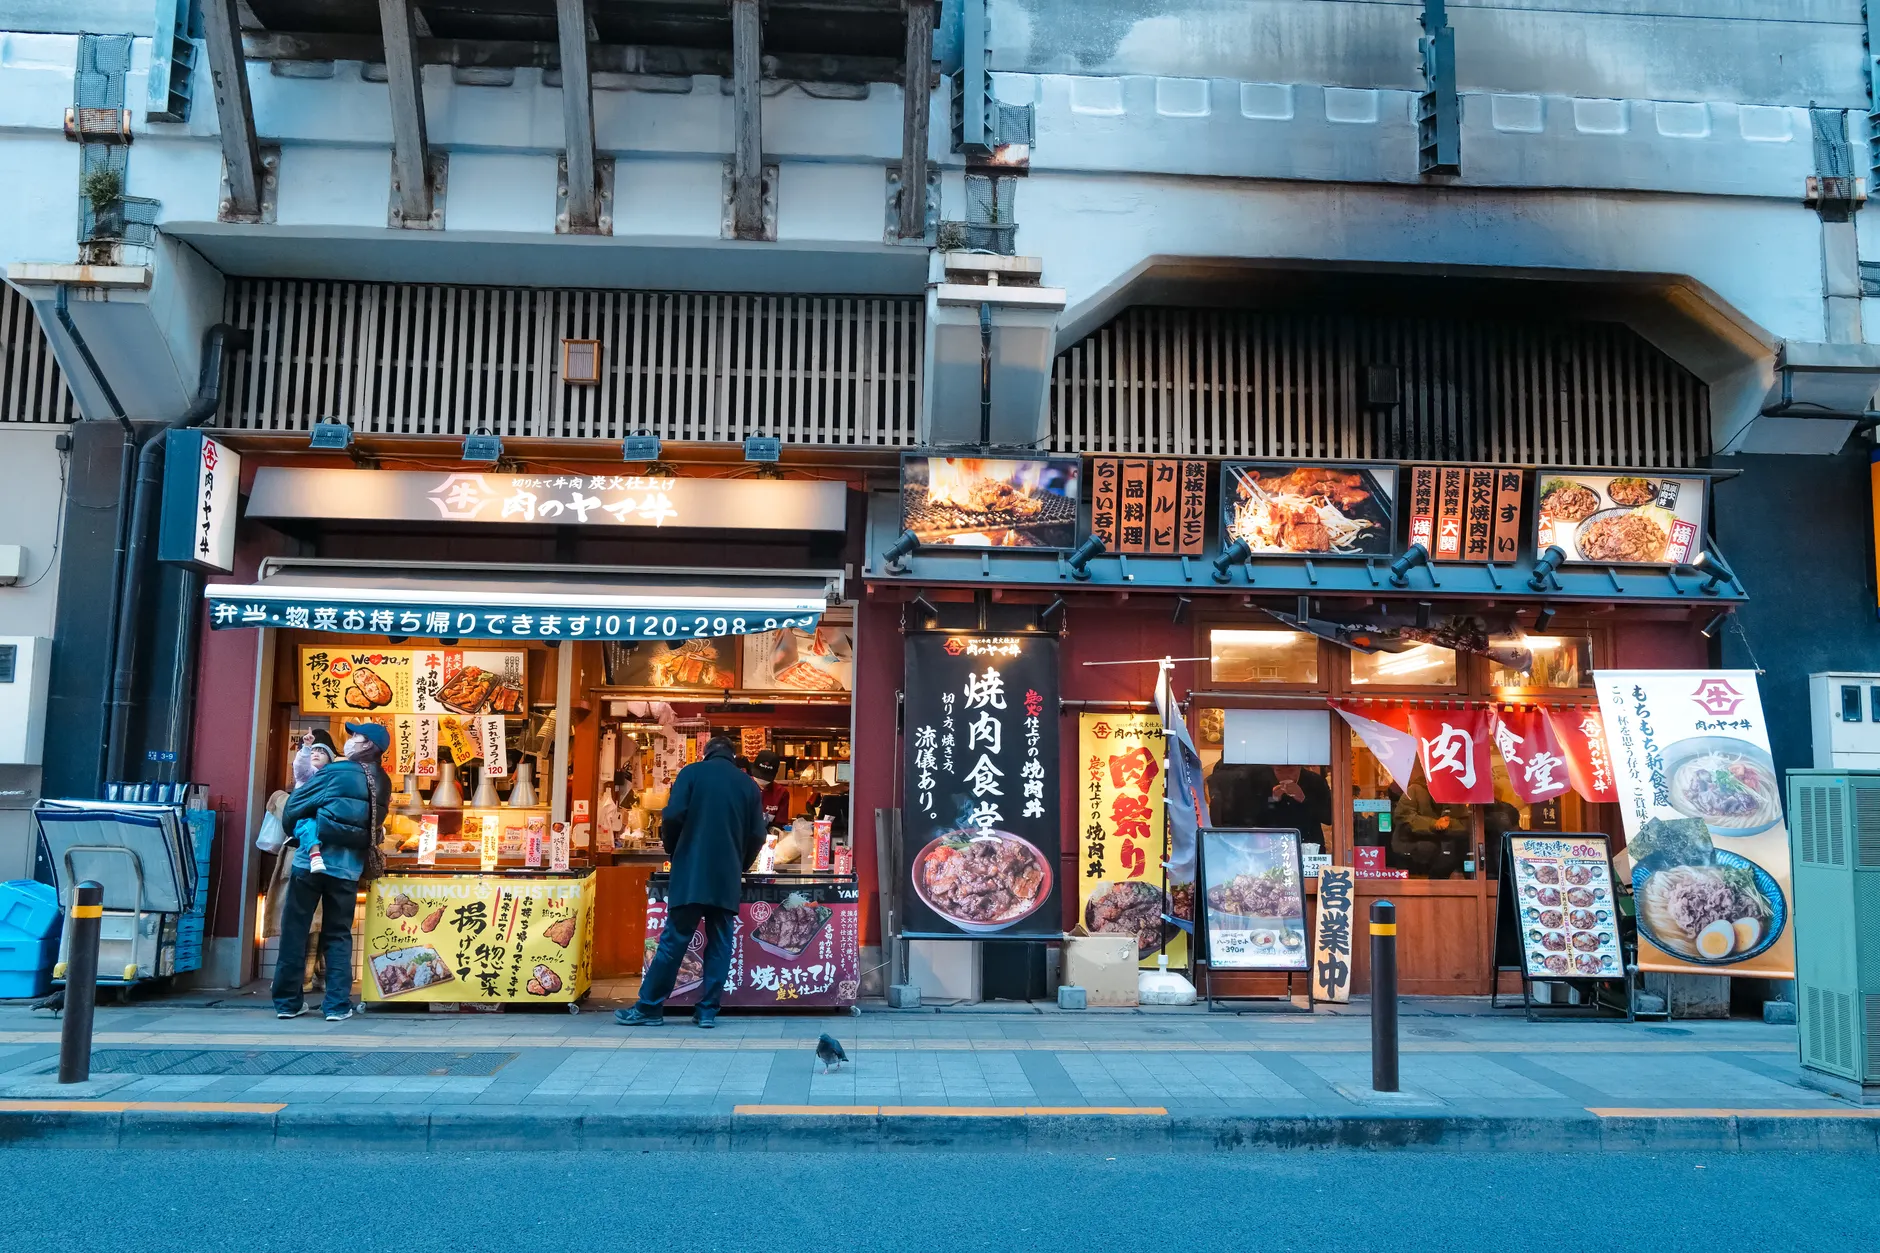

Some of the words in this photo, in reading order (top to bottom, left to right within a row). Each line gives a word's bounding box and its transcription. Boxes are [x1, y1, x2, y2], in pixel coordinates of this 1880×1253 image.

[500, 488, 679, 528] 肉のヤマ牛
[512, 477, 583, 490] 切りたて牛肉
[588, 475, 676, 492] 炭火仕上げ
[1094, 461, 1115, 544] ちょい呑み
[1123, 463, 1145, 545] 一品料理
[1154, 463, 1174, 546] カルビ
[1183, 462, 1205, 546] 鉄板ホルモン
[1416, 470, 1431, 515] 炭火焼肉丼
[1444, 470, 1460, 515] 炭火焼肉丼
[200, 470, 213, 558] 肉のヤマ牛
[1440, 521, 1458, 551] 大関
[1468, 471, 1492, 553] 炭火焼肉丼
[1498, 472, 1520, 553] 肉すい
[306, 652, 329, 700] 揚げたて
[351, 654, 370, 664] We
[419, 719, 430, 759] メンチカツ
[941, 692, 956, 775] 切り方、焼き方、
[1114, 728, 1166, 740] 肉のヤマ牛
[1631, 685, 1673, 807] もちもち新食感
[1695, 719, 1752, 731] 肉のヤマ牛
[418, 766, 435, 774] 250
[457, 751, 471, 763] 130
[488, 766, 503, 775] 120
[914, 725, 938, 819] 流儀あり。
[963, 666, 1007, 843] 焼肉食堂
[1020, 689, 1045, 818] 炭火仕上げの焼肉丼
[1587, 737, 1608, 794] 肉のヤマ牛
[1085, 755, 1106, 879] 炭火仕上げの焼肉丼
[1108, 746, 1160, 879] 肉祭り
[1360, 849, 1379, 858] 入口
[377, 884, 470, 898] YAKINIKU
[496, 882, 581, 899] MEISTER
[495, 892, 513, 941] 出来立ての
[450, 901, 487, 983] 揚げたて
[506, 896, 533, 998] お持ち帰りできます
[1318, 869, 1353, 999] 営業中
[475, 943, 505, 997] 惣菜
[750, 962, 836, 991] 焼きたて!!
[776, 983, 831, 1001] 炭火仕上げ
